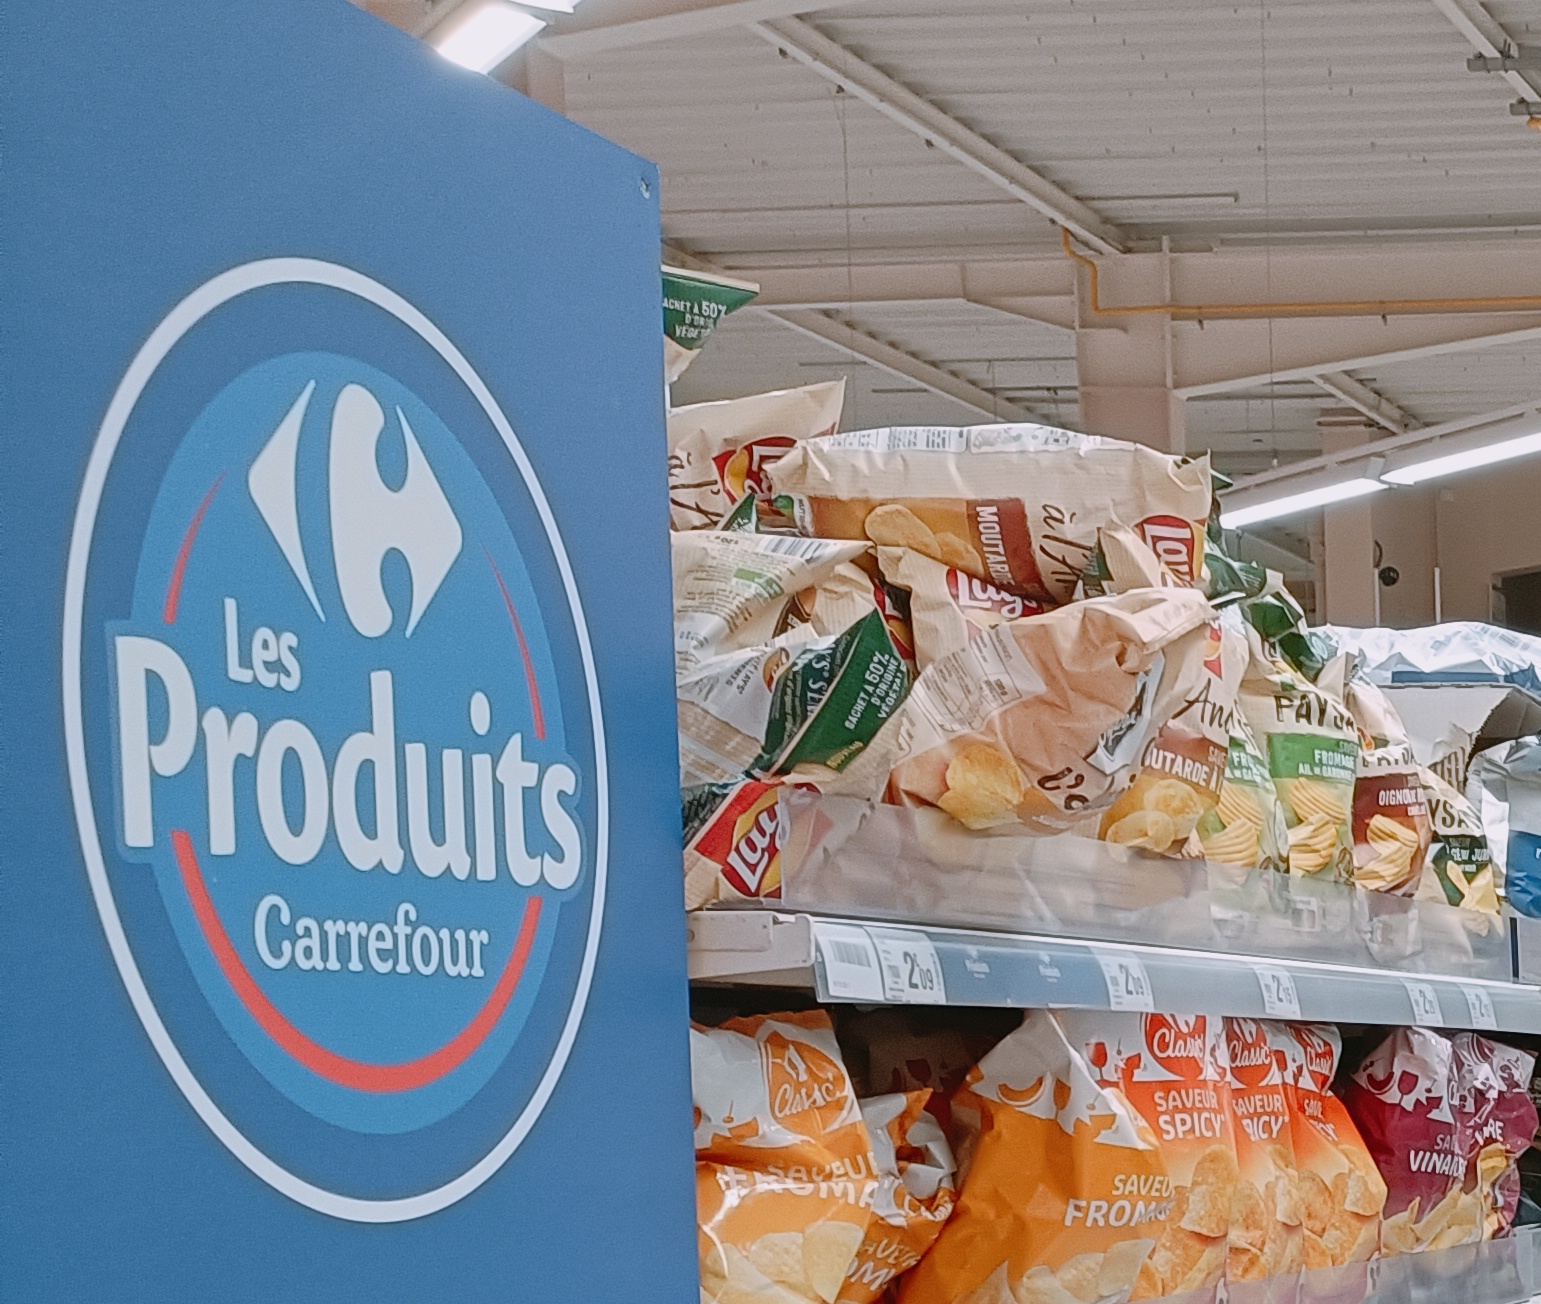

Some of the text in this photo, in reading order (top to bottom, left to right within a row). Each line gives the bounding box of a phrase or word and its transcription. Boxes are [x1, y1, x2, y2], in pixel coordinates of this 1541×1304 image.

[223, 597, 301, 692] Les
[867, 651, 890, 683] 50%
[114, 634, 584, 891] Produits
[253, 893, 490, 979] Carrefour
[1154, 1091, 1220, 1112] SAVEUR
[1112, 1174, 1173, 1198] SAVEU
